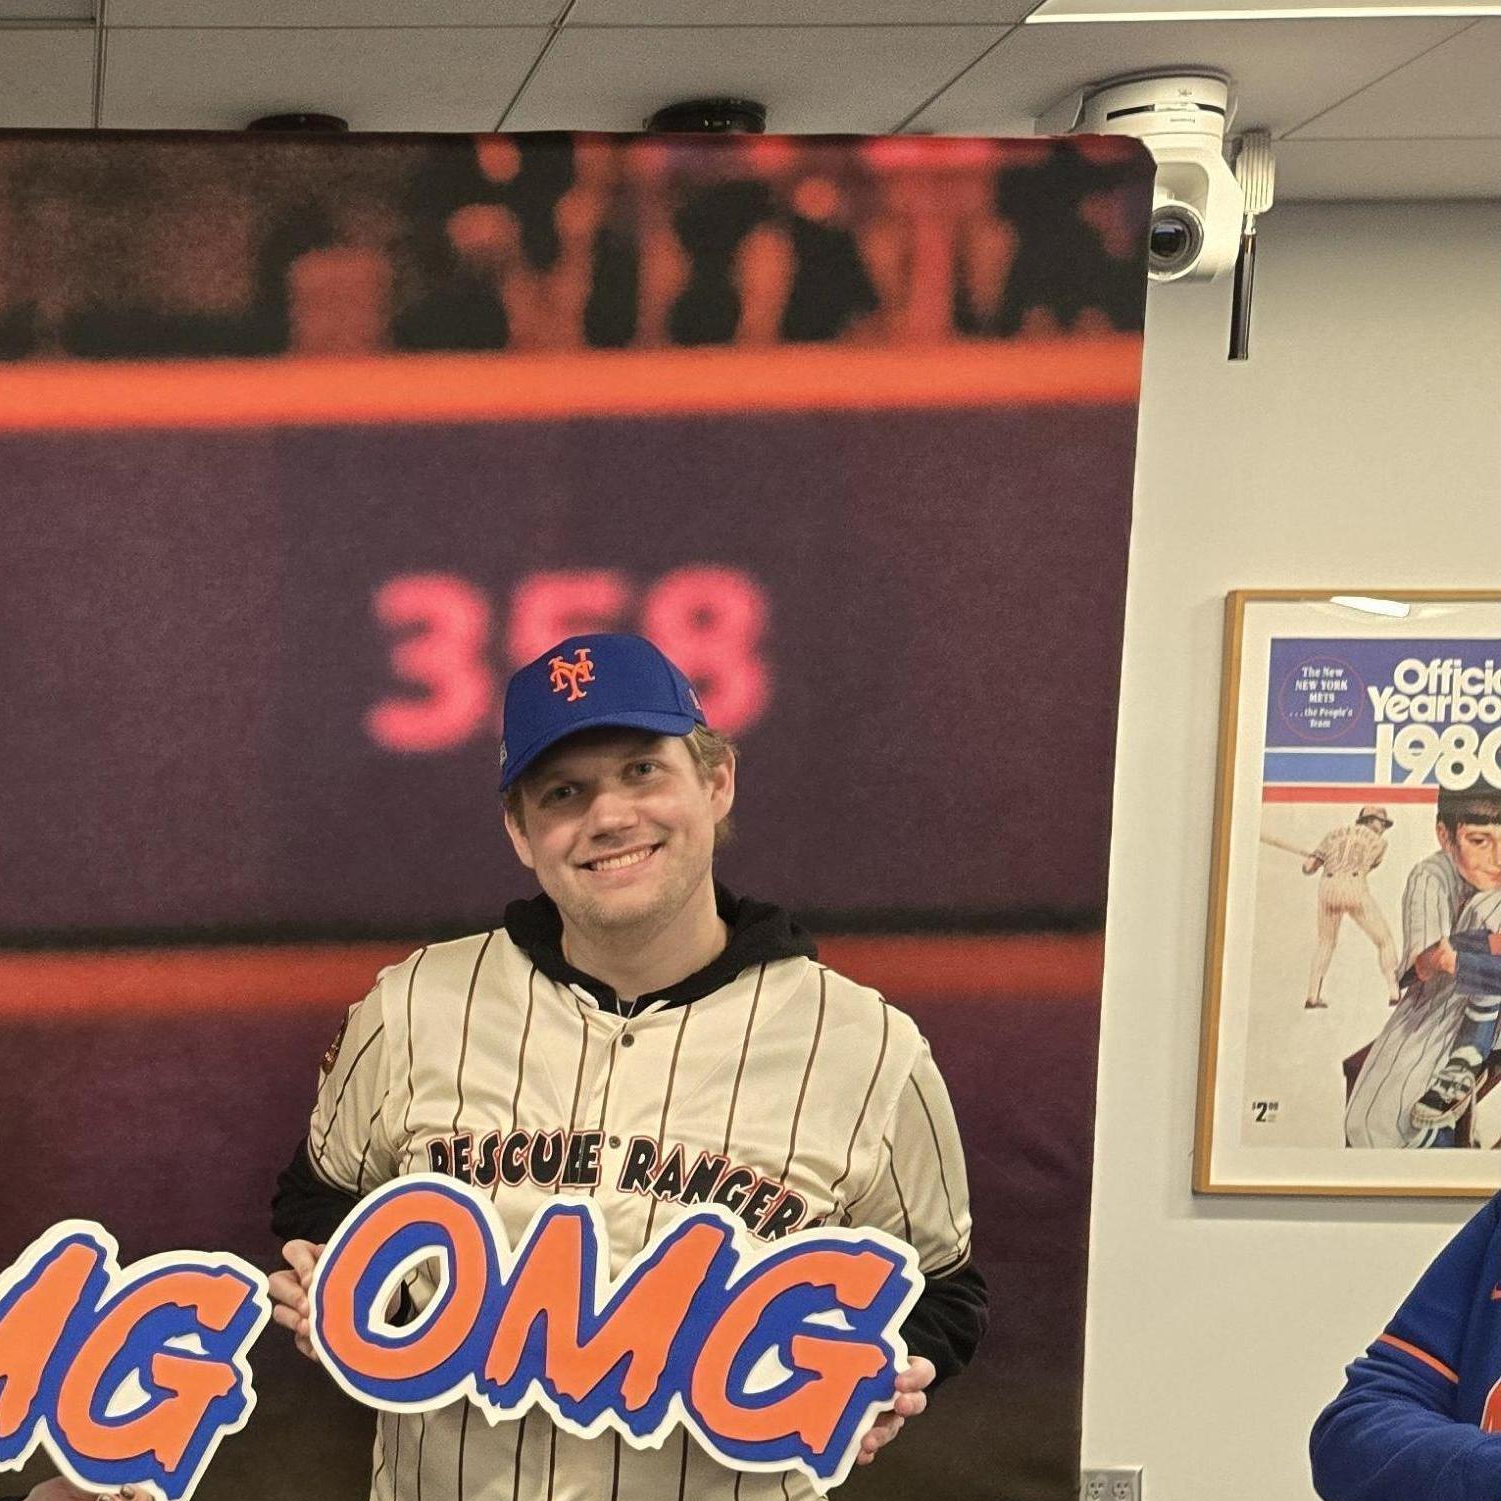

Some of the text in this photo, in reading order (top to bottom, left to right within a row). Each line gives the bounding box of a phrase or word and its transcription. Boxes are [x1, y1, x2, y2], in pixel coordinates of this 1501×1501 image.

[1302, 666, 1344, 678] The New
[1394, 658, 1501, 696] Offici
[1295, 679, 1348, 692] NEW YORK
[1309, 691, 1335, 703] METS
[1319, 706, 1353, 720] People's
[1309, 718, 1331, 729] Team
[427, 1127, 831, 1243] RESCUE RANGER
[314, 1180, 917, 1480] OMG
